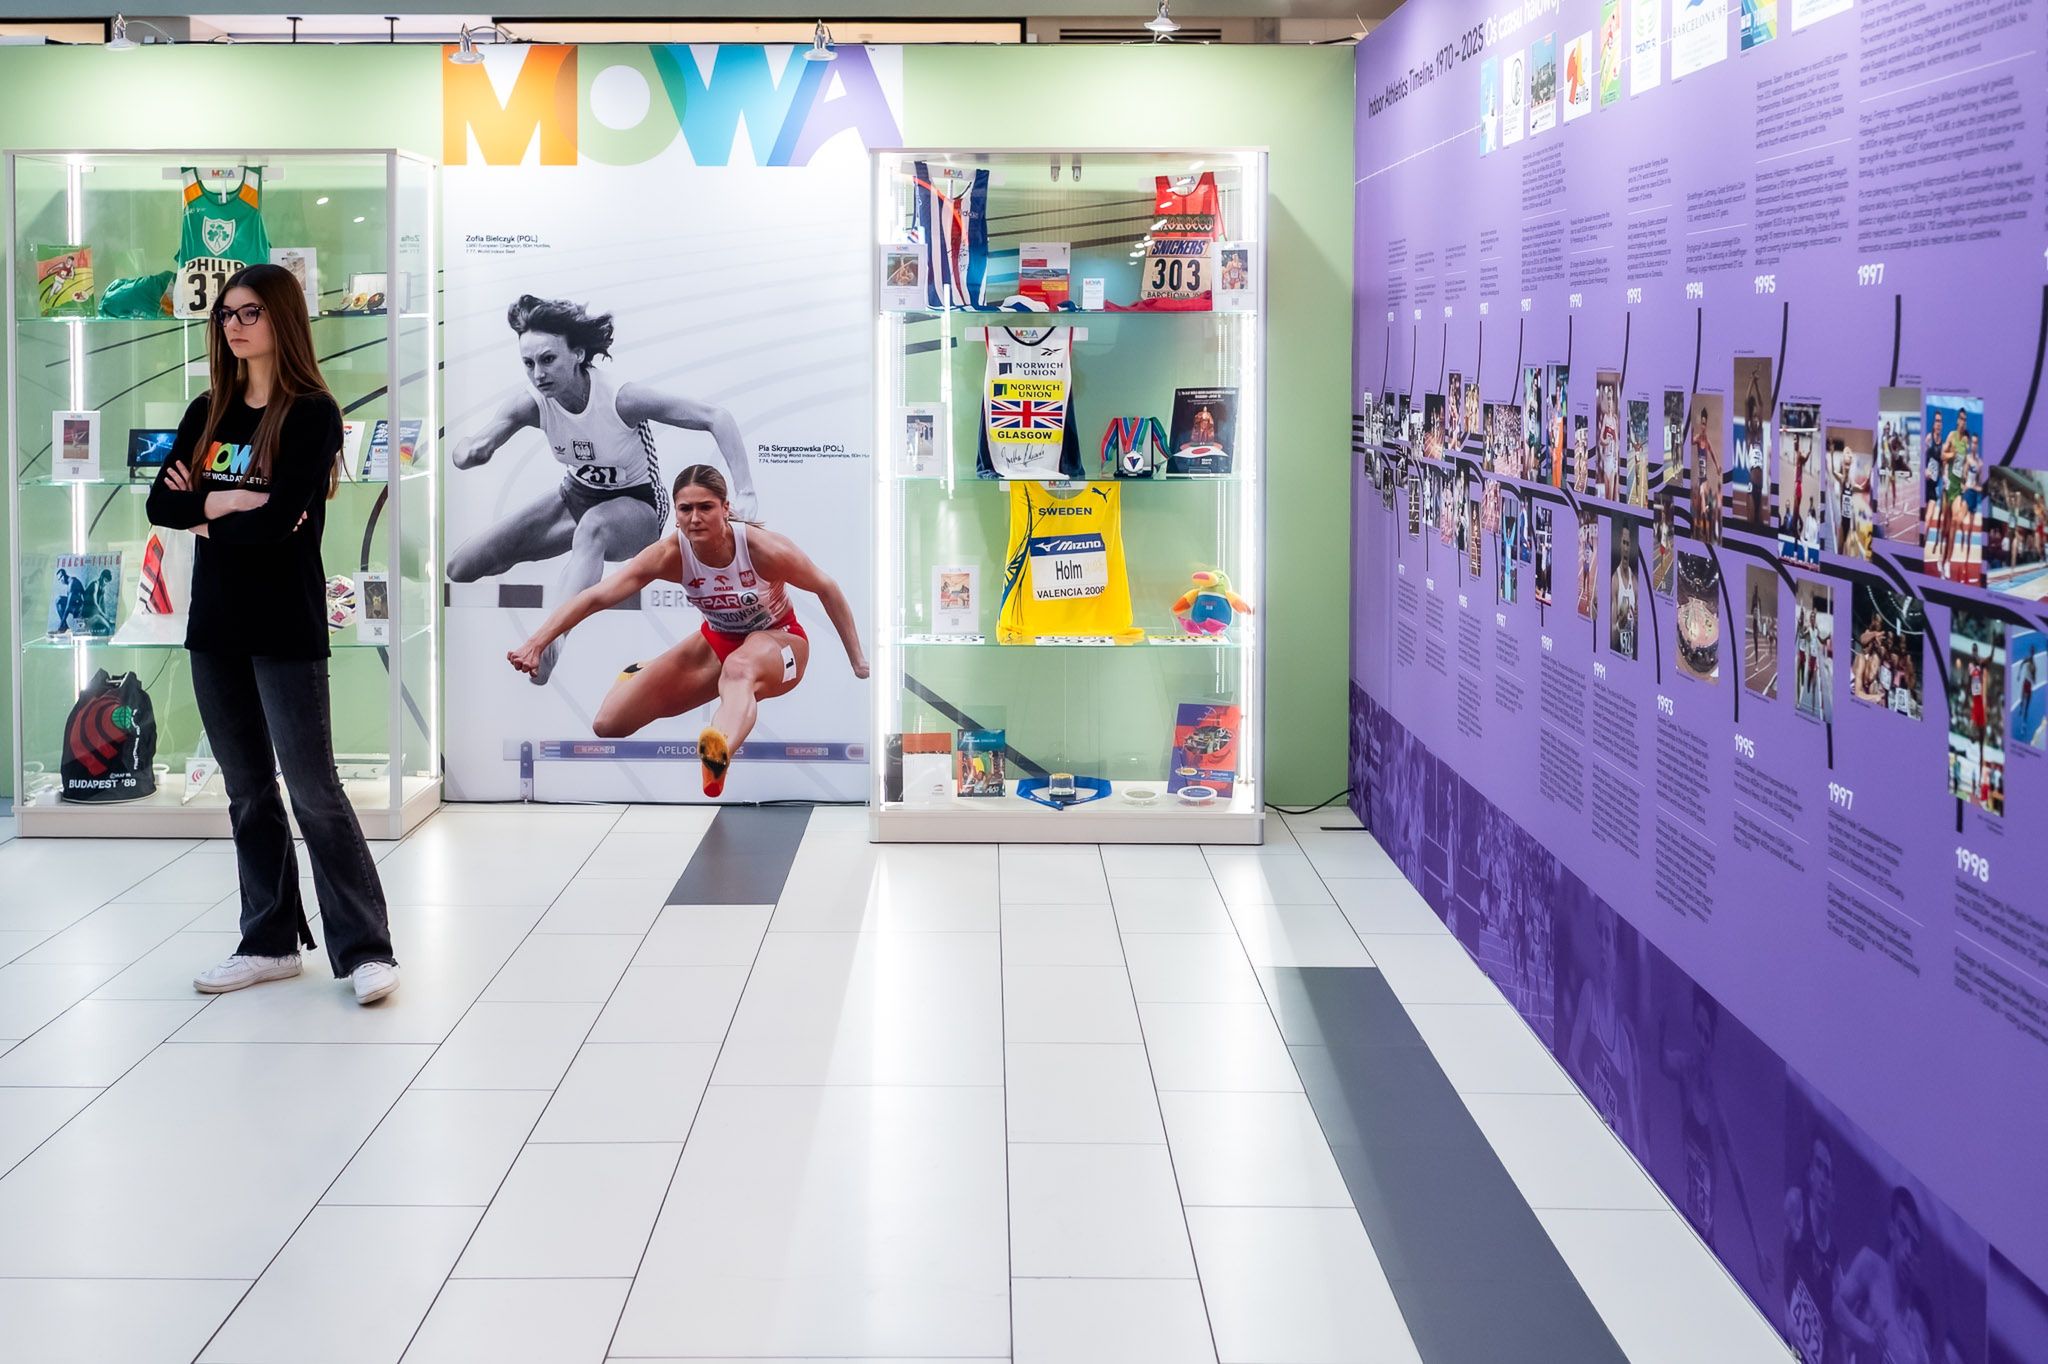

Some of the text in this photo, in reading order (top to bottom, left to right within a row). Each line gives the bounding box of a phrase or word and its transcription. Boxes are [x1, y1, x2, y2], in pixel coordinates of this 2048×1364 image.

[1368, 91, 1385, 119] Indoor
[1384, 77, 1408, 108] Athletics
[1409, 61, 1434, 94] Timeline,
[1435, 43, 1453, 77] 1970
[1461, 23, 1484, 62] 2025
[443, 45, 903, 167] MOWA
[486, 235, 514, 243] Bielczyk
[517, 235, 538, 243] (POL)
[1152, 240, 1206, 255] SNICKERS
[1152, 258, 1201, 291] 303
[1858, 263, 1884, 286] 1997
[1686, 282, 1703, 299] 1994
[1754, 275, 1776, 294] 1995
[1010, 383, 1060, 391] NORWICH
[997, 431, 1052, 440] GLASGOW
[772, 445, 821, 454] Skrzyszowska
[823, 445, 845, 453] (POL)
[212, 472, 235, 482] WORLD
[1039, 507, 1092, 516] SWEDEN
[1056, 560, 1083, 580] Holm
[1037, 588, 1083, 599] VALENCIA
[1593, 662, 1606, 680] 1991
[1657, 695, 1674, 716] 1993
[1734, 733, 1754, 759] 1995
[69, 777, 137, 789] BUDAPEST '89
[1828, 781, 1853, 811] 1997
[1956, 846, 1989, 883] 1998
